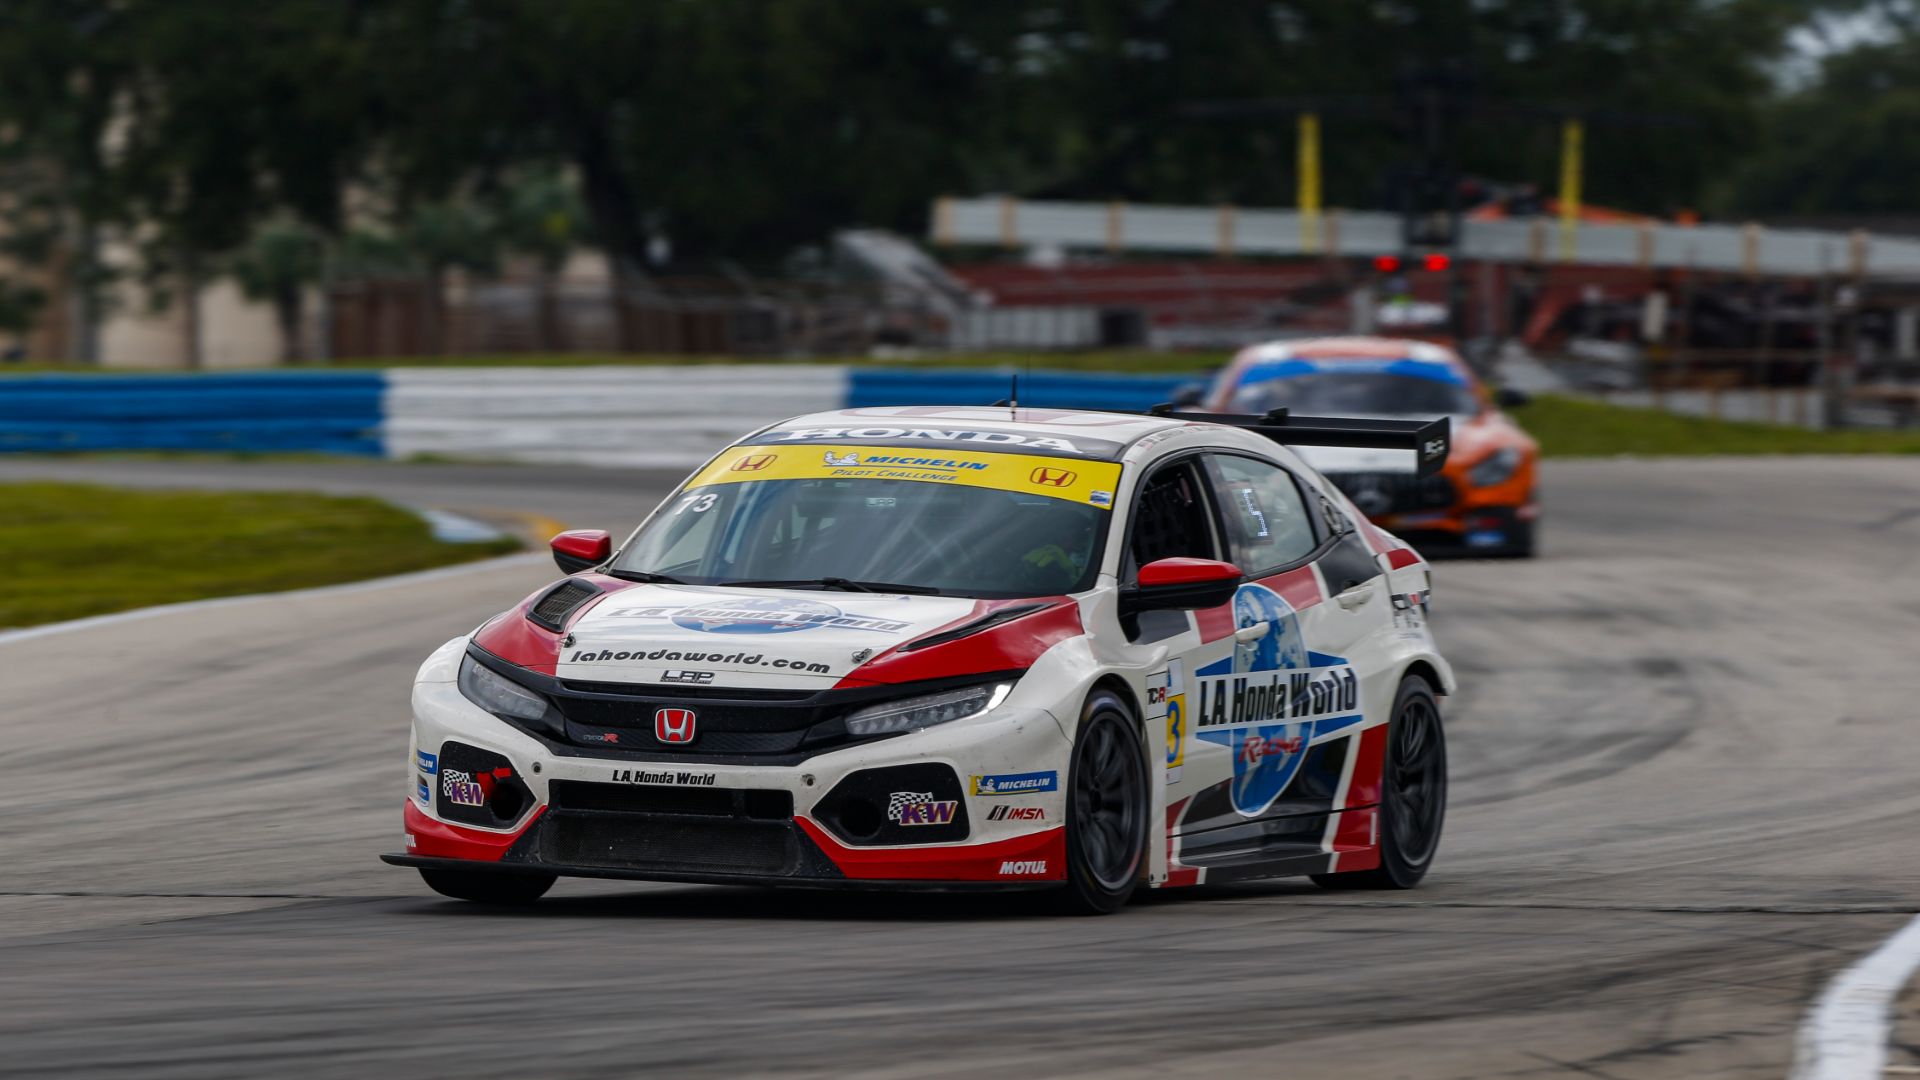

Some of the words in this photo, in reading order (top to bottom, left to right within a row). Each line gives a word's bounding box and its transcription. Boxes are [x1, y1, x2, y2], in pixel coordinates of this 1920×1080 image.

[779, 428, 1083, 454] HONDA
[864, 456, 989, 471] MICHELIN
[675, 493, 718, 515] 73
[793, 614, 910, 631] World
[570, 649, 830, 674] lahondaworld.com
[1231, 674, 1286, 724] Honda
[1291, 668, 1357, 717] World
[634, 771, 674, 784] Honda
[677, 772, 715, 785] World
[998, 778, 1050, 790] MICHELIN
[451, 781, 484, 806] KW
[900, 801, 958, 826] KW
[1007, 808, 1045, 820] IMSA
[999, 861, 1047, 875] MOTUL
